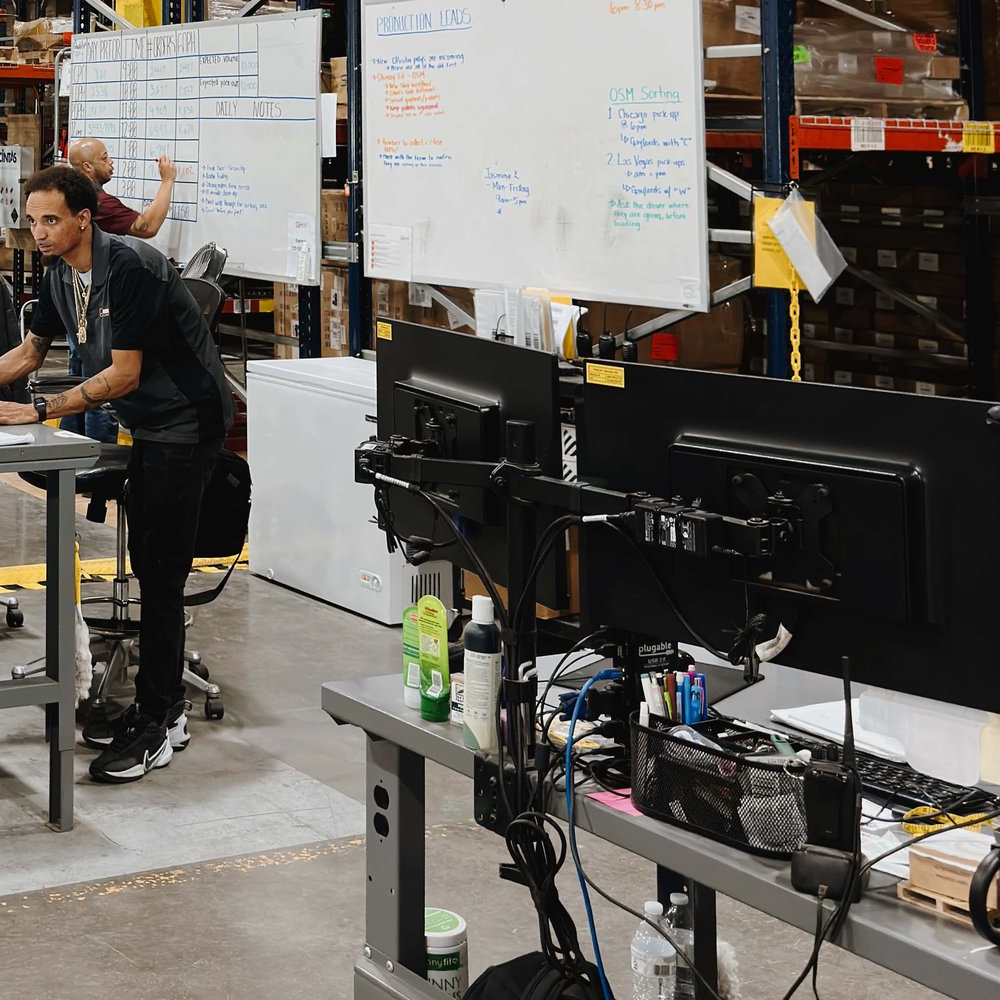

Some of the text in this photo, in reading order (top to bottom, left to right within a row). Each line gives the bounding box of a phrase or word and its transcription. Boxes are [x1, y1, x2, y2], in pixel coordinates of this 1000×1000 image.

[376, 8, 472, 33] PRODUCTION LEADS
[100, 38, 121, 60] PRIOR
[123, 36, 146, 60] TIME
[200, 56, 221, 64] EXPECTED
[200, 79, 219, 89] Expected
[609, 85, 680, 102] OSM Sorting
[216, 101, 282, 118] DAILY NOTES
[618, 108, 648, 124] Chicago
[663, 138, 679, 147] with
[618, 152, 632, 166] Las
[634, 156, 653, 169] Vegas
[614, 220, 640, 231] loading
[638, 642, 672, 654] plugable
